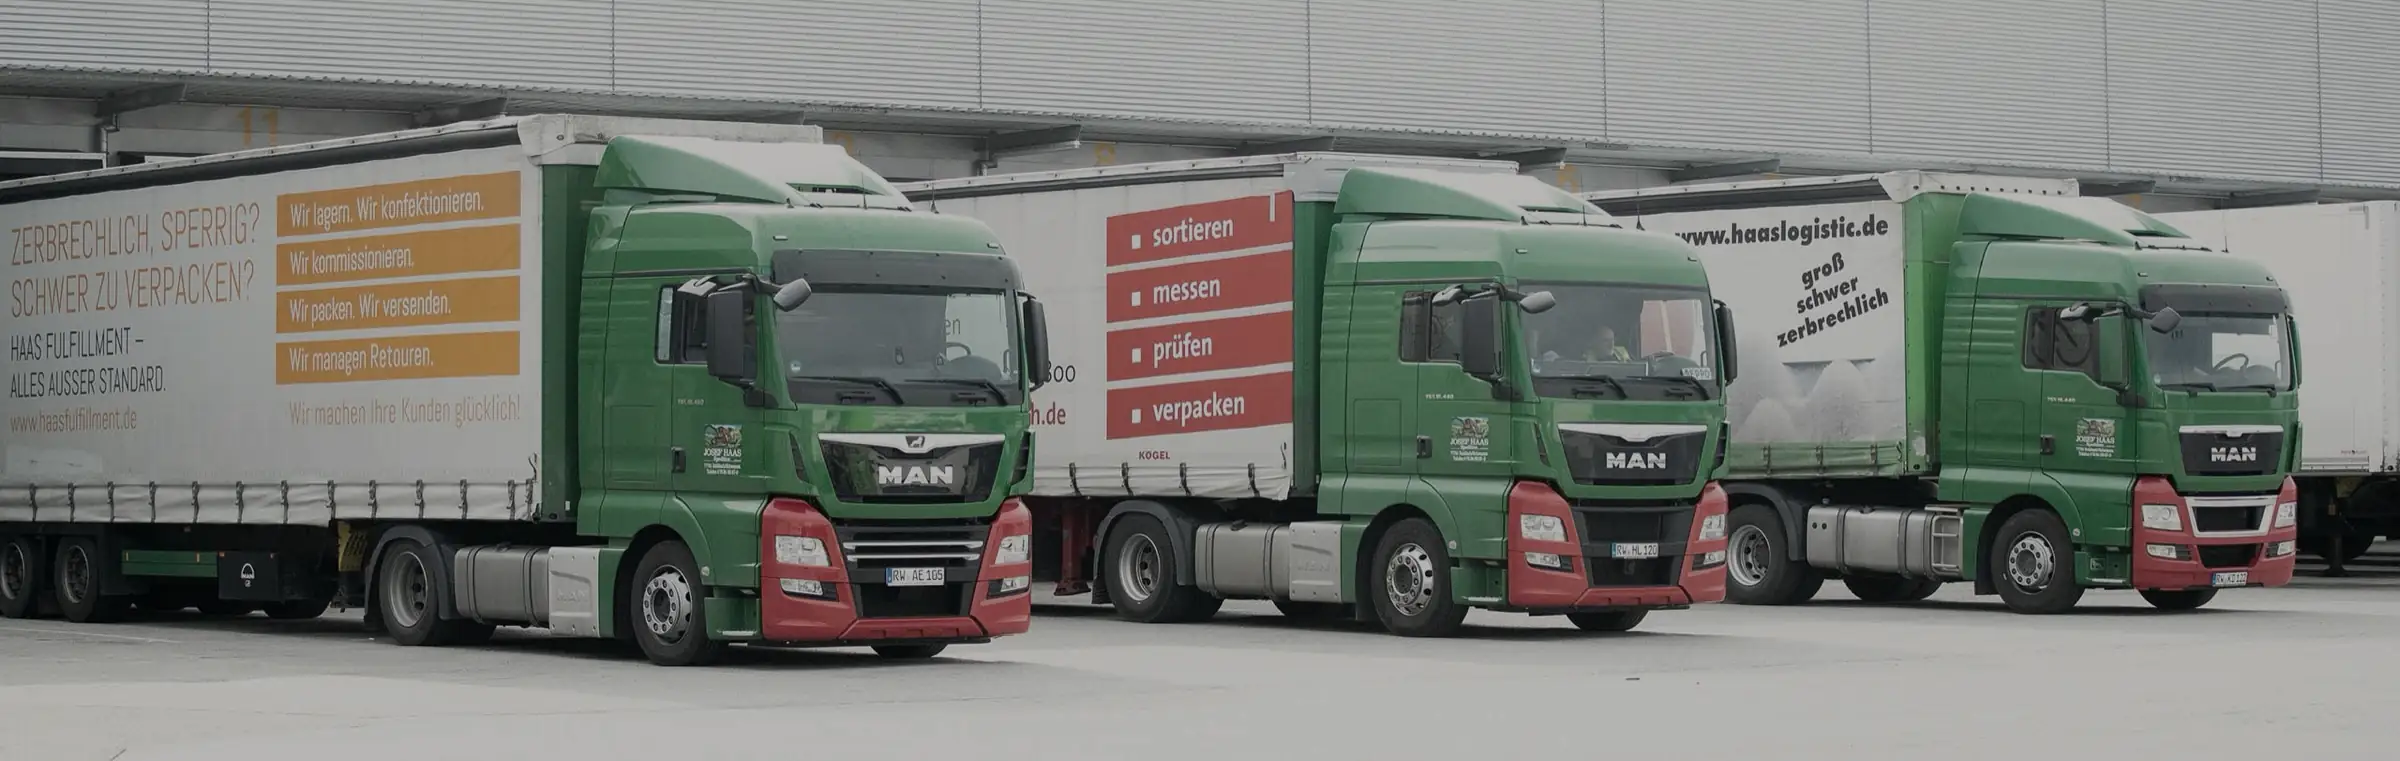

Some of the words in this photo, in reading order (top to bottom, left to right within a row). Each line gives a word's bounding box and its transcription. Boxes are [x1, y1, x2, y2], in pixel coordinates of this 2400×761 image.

[290, 203, 311, 228] Wir
[313, 203, 353, 232] lagern.
[356, 195, 378, 222] Wir
[381, 188, 484, 220] konfektionieren.
[11, 213, 154, 266] ZERBRECHLICH,
[161, 202, 260, 251] SPERRIG?
[1153, 217, 1234, 247] sortieren
[290, 250, 309, 275] Wir
[311, 245, 414, 275] kommissionieren.
[1802, 252, 1845, 290] groß
[11, 274, 89, 318] SCHWER
[95, 270, 119, 311] ZU
[124, 259, 255, 308] VERPACKEN?
[1153, 278, 1220, 304] messen
[1797, 276, 1859, 314] schwer
[289, 298, 308, 323] Wir
[311, 297, 355, 329] packen.
[359, 293, 379, 319] Wir
[383, 288, 451, 316] versenden.
[1776, 287, 1889, 348] zerbrechlich
[10, 333, 42, 361] HAAS
[46, 327, 131, 359] FULFILLMENT
[289, 347, 309, 372] Wir
[312, 349, 367, 376] managen
[370, 343, 434, 369] Retouren.
[1153, 332, 1212, 369] prüfen
[10, 371, 45, 398] ALLES
[48, 368, 96, 397] AUSSER
[99, 365, 166, 394] STANDARD.
[10, 406, 137, 434] www.haasfulfillment.de
[290, 400, 311, 425] Wir
[314, 399, 366, 426] machen
[370, 397, 397, 424] Ihre
[401, 396, 450, 423] Kunden
[454, 394, 520, 428] glücklich!
[1152, 391, 1245, 427] verpacken
[1606, 452, 1666, 469] MAN
[2211, 447, 2257, 462] MAN
[878, 466, 954, 484] MAN
[893, 570, 906, 581] RW
